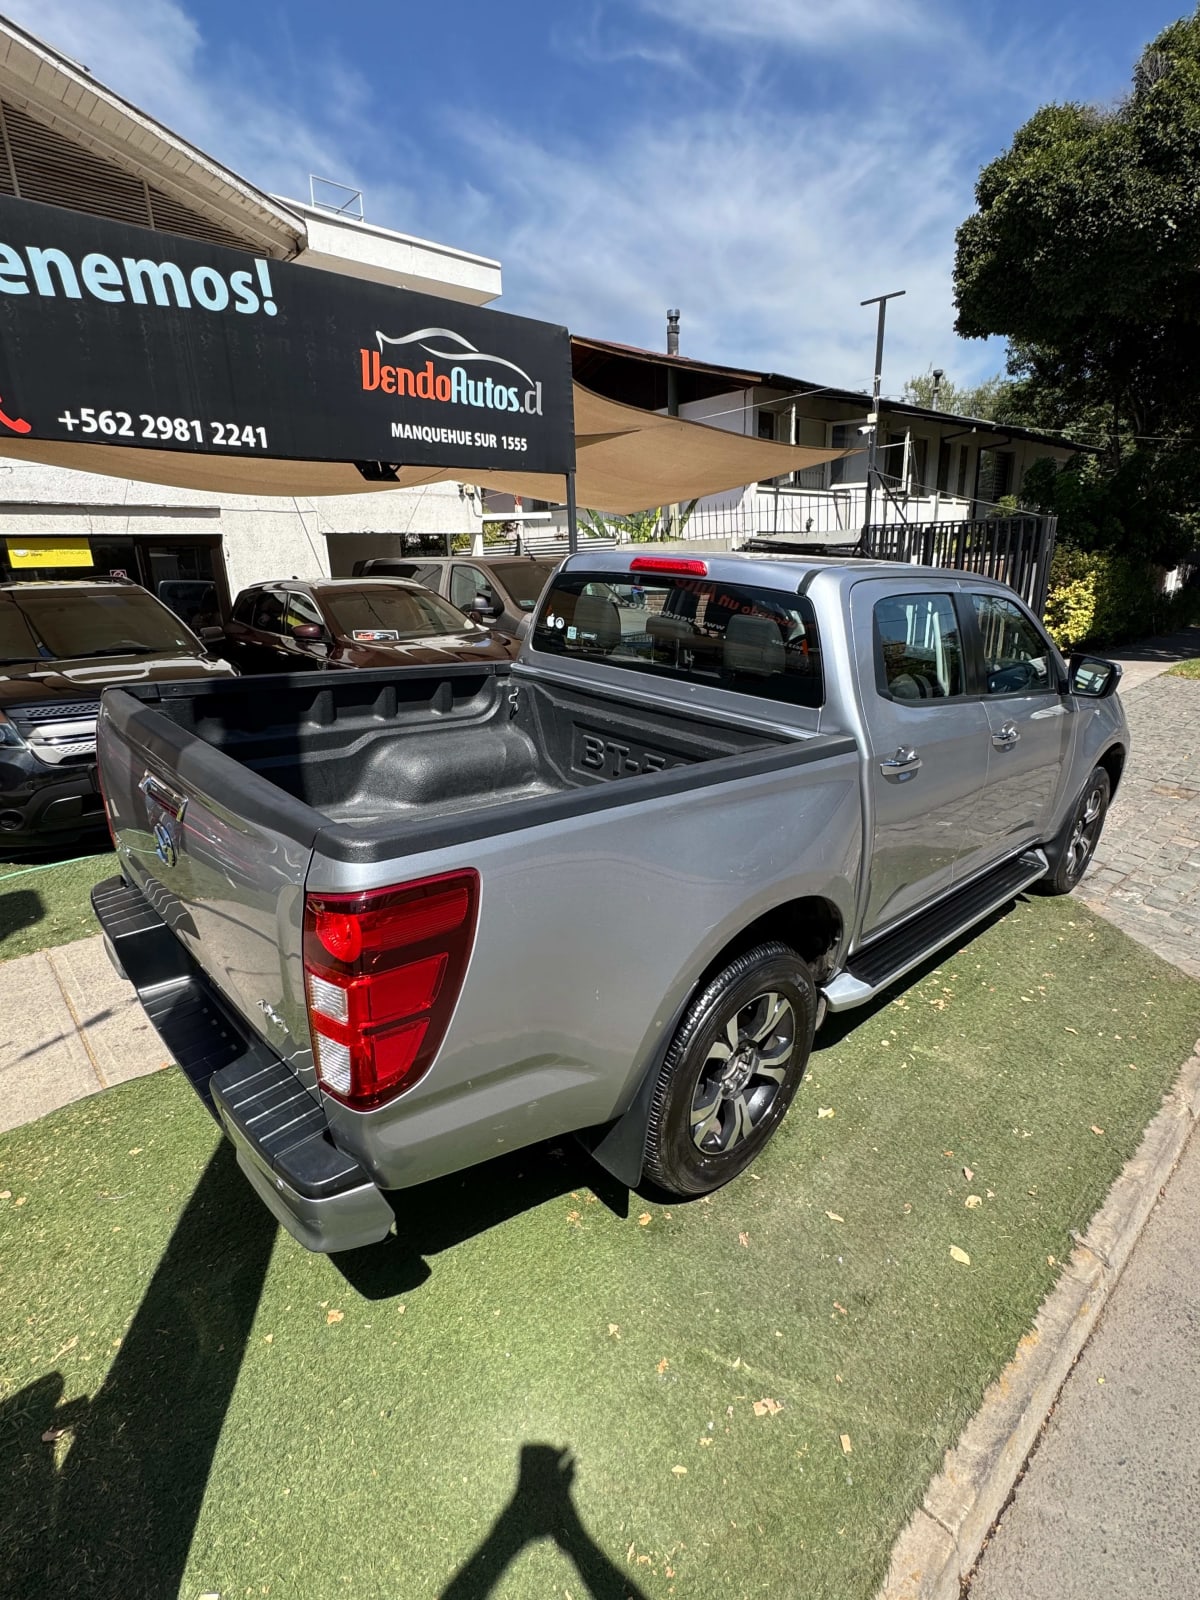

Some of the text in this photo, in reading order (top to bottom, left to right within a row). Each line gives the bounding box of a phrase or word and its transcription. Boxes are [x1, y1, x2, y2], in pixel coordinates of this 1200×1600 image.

[360, 348, 543, 416] VendoAutos.cl
[57, 407, 268, 448] +562 2981 2241
[391, 422, 528, 451] MANQUEHUE SUR 1555
[581, 734, 688, 777] BT-5
